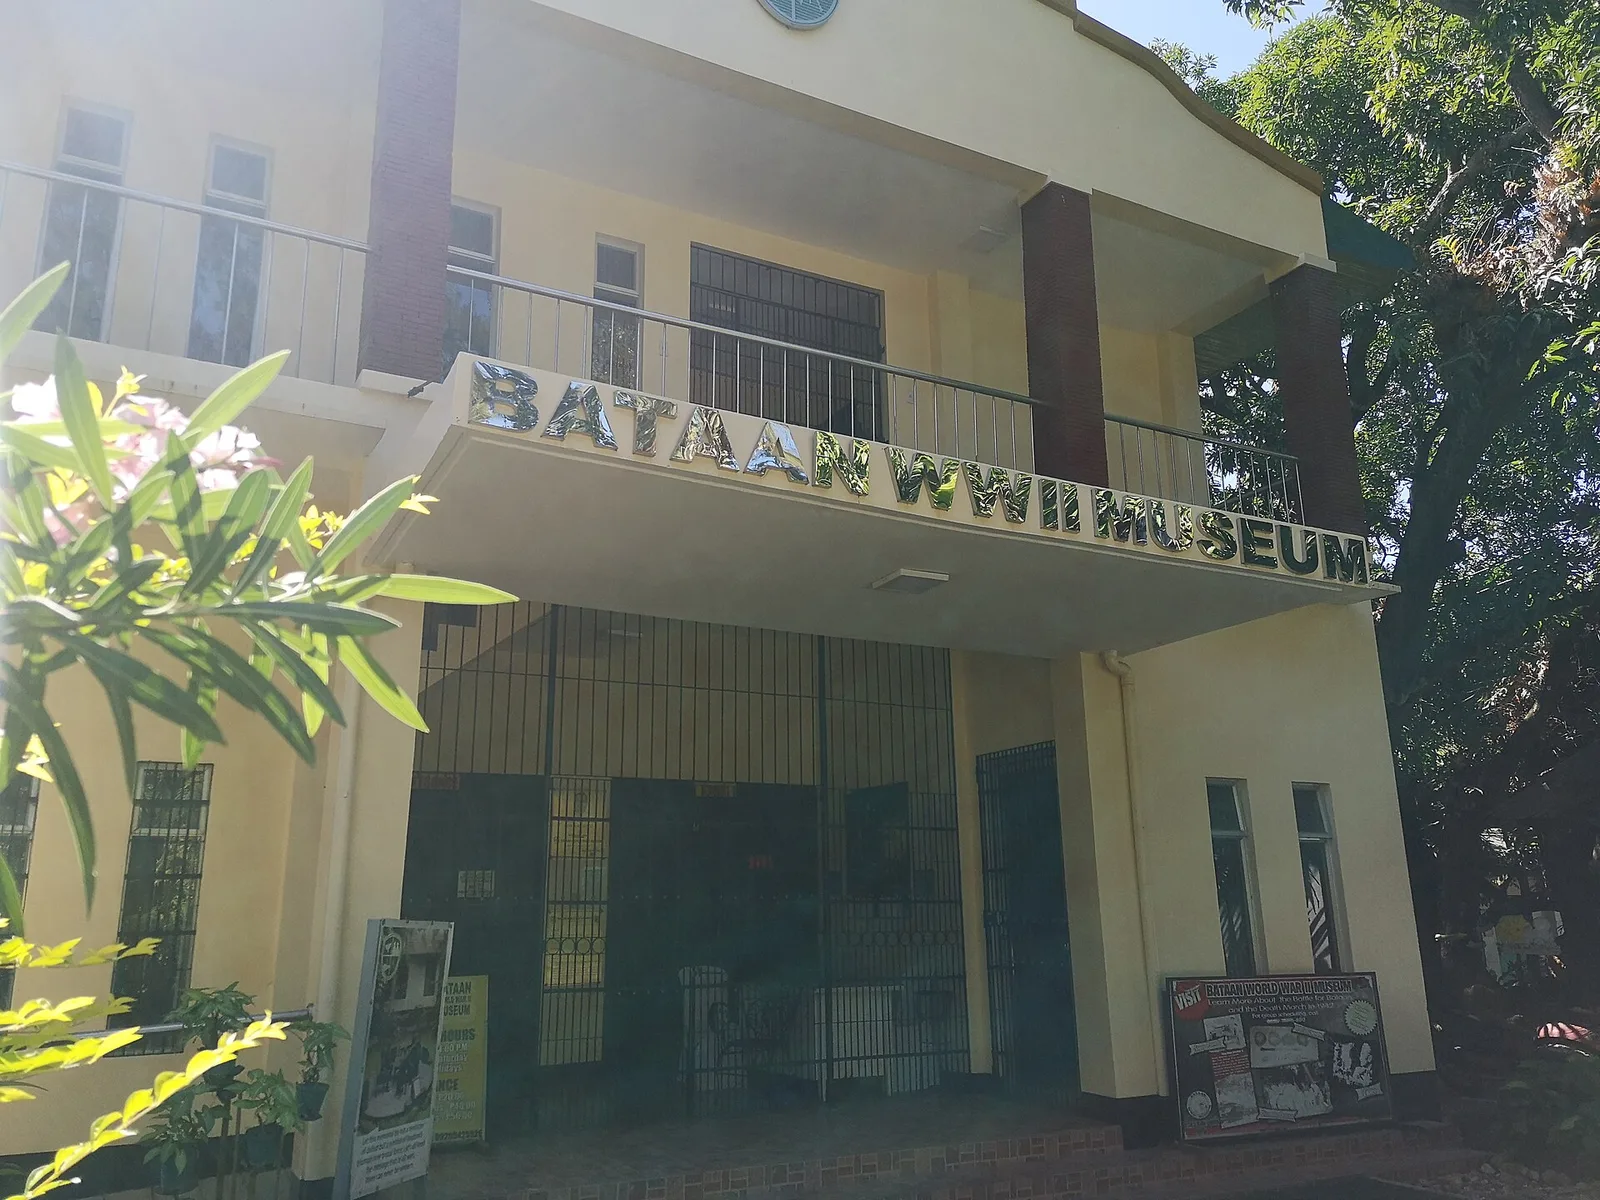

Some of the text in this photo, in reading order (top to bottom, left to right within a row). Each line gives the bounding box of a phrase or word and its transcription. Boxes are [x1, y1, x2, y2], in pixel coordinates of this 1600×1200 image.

[469, 360, 870, 496] BATAAN
[1092, 488, 1369, 585] MUSEUM
[1206, 980, 1352, 998] BATAAN WORLD WAR II MUSEUM
[1175, 987, 1202, 1011] VISIT
[1208, 998, 1230, 1006] Learn
[1254, 996, 1276, 1004] About
[1283, 1003, 1307, 1011] March
